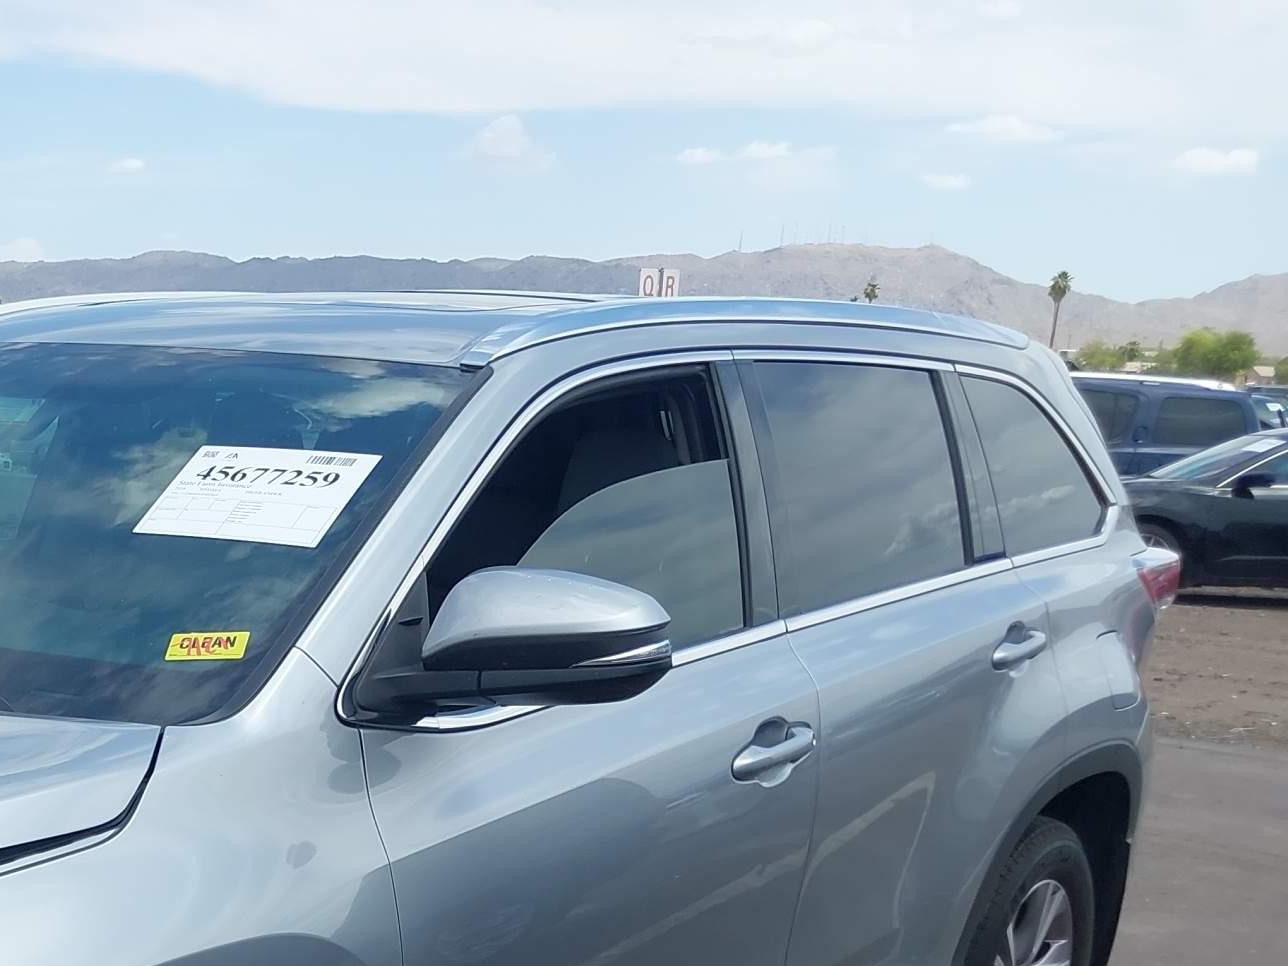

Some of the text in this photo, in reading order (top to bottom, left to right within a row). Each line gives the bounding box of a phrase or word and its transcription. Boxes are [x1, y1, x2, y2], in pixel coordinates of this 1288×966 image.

[665, 276, 675, 297] R
[196, 465, 341, 489] 45677259
[179, 636, 238, 649] CLEAN
